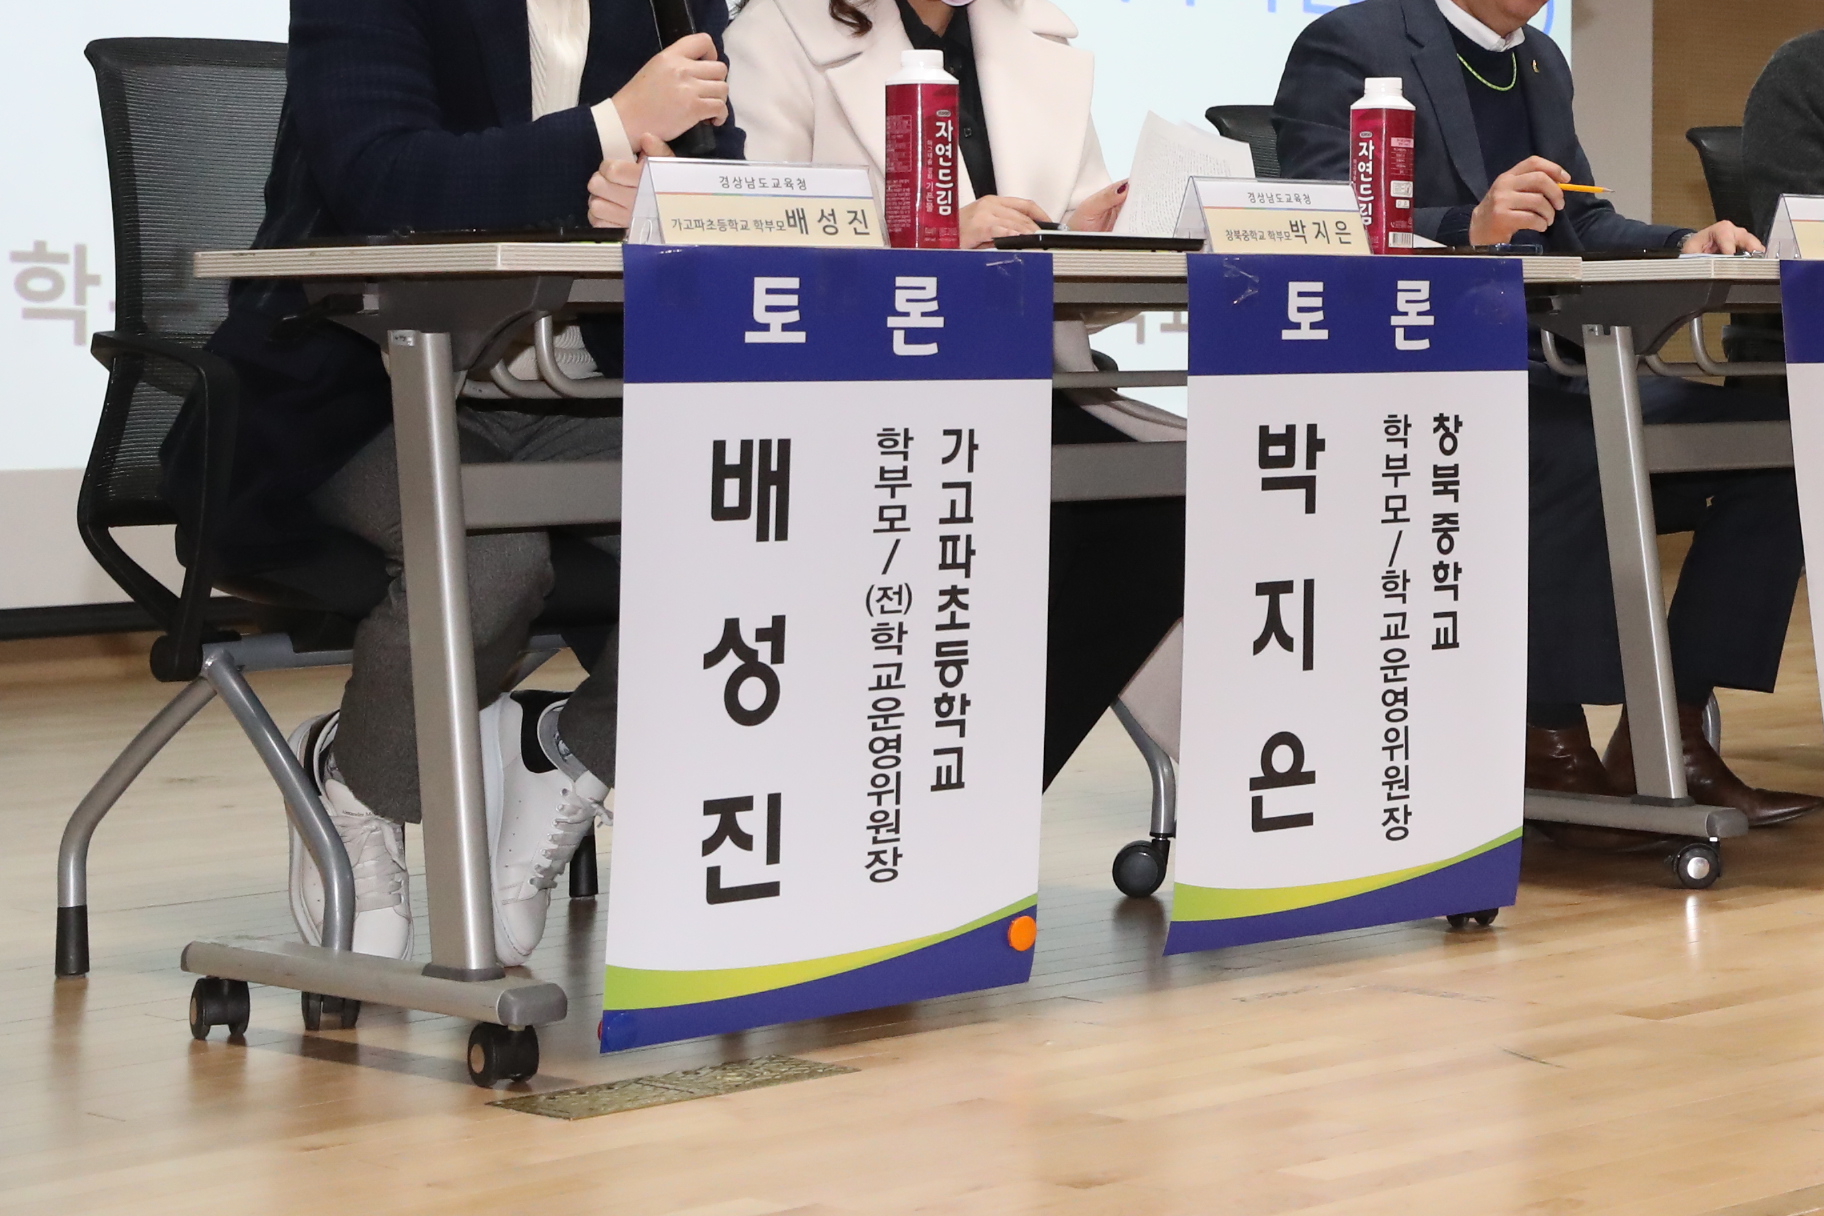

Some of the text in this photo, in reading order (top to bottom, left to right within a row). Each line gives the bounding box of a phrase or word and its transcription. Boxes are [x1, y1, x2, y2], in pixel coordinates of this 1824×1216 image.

[719, 175, 807, 191] 경상남도교육청
[934, 119, 954, 216] 자연드림
[1247, 191, 1312, 205] 경상남도교육청
[1358, 139, 1375, 226] 자연드림
[671, 207, 870, 236] 가고파초등학교 학부모 배성진
[1225, 229, 1266, 242] 창북중학교
[1289, 219, 1352, 245] 박지은
[1431, 412, 1463, 651] 창북중학교
[930, 428, 979, 792] 가고파초등학교
[1249, 423, 1326, 833] 박지은
[702, 438, 792, 906] 배성진
